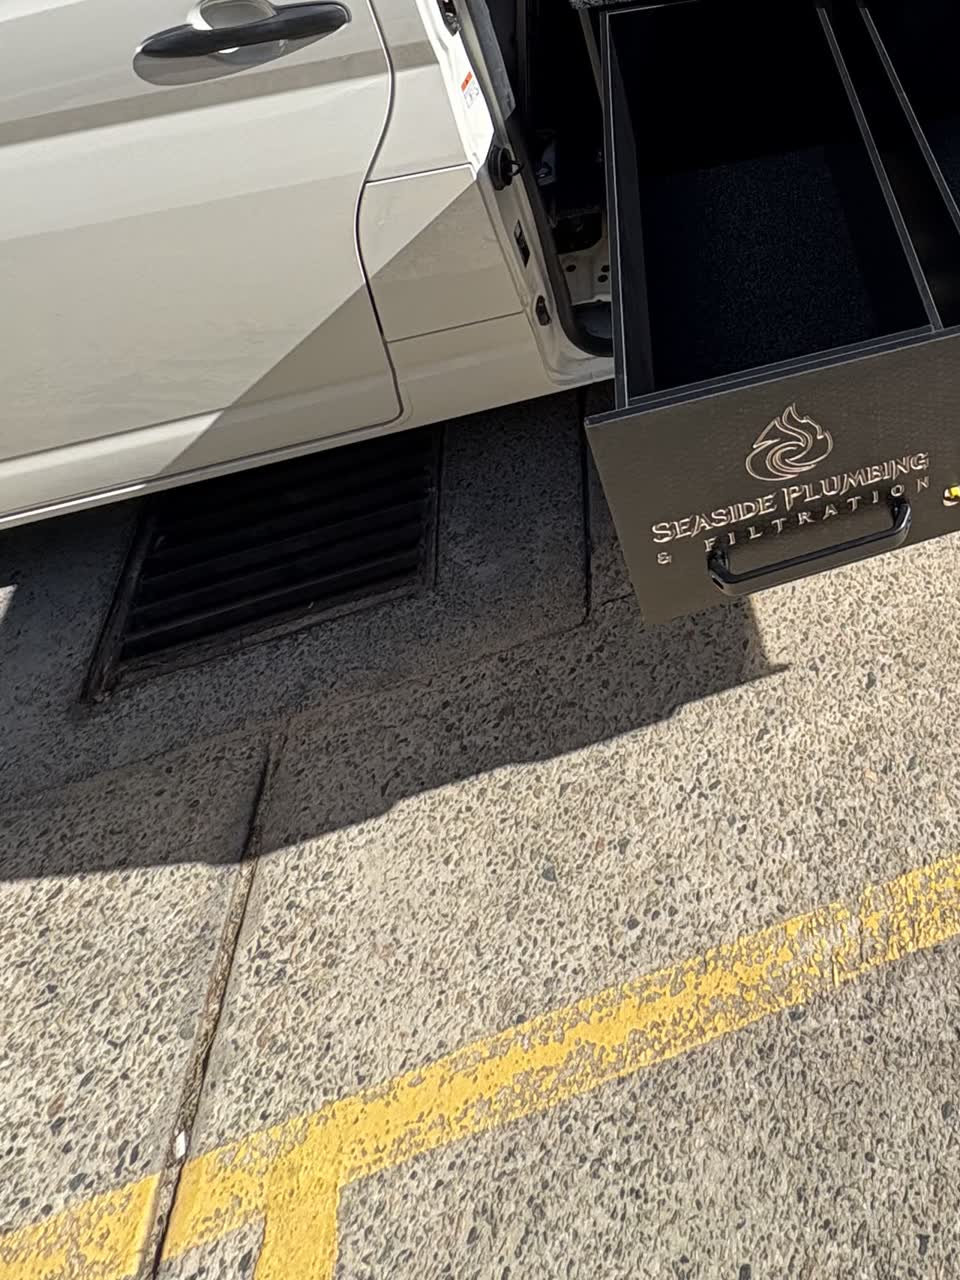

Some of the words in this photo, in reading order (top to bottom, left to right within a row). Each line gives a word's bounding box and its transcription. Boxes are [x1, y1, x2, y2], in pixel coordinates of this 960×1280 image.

[652, 492, 778, 543] SEASIDE
[781, 452, 930, 512] PLUMBING
[656, 551, 673, 565] &
[703, 475, 930, 553] FILTRATION
